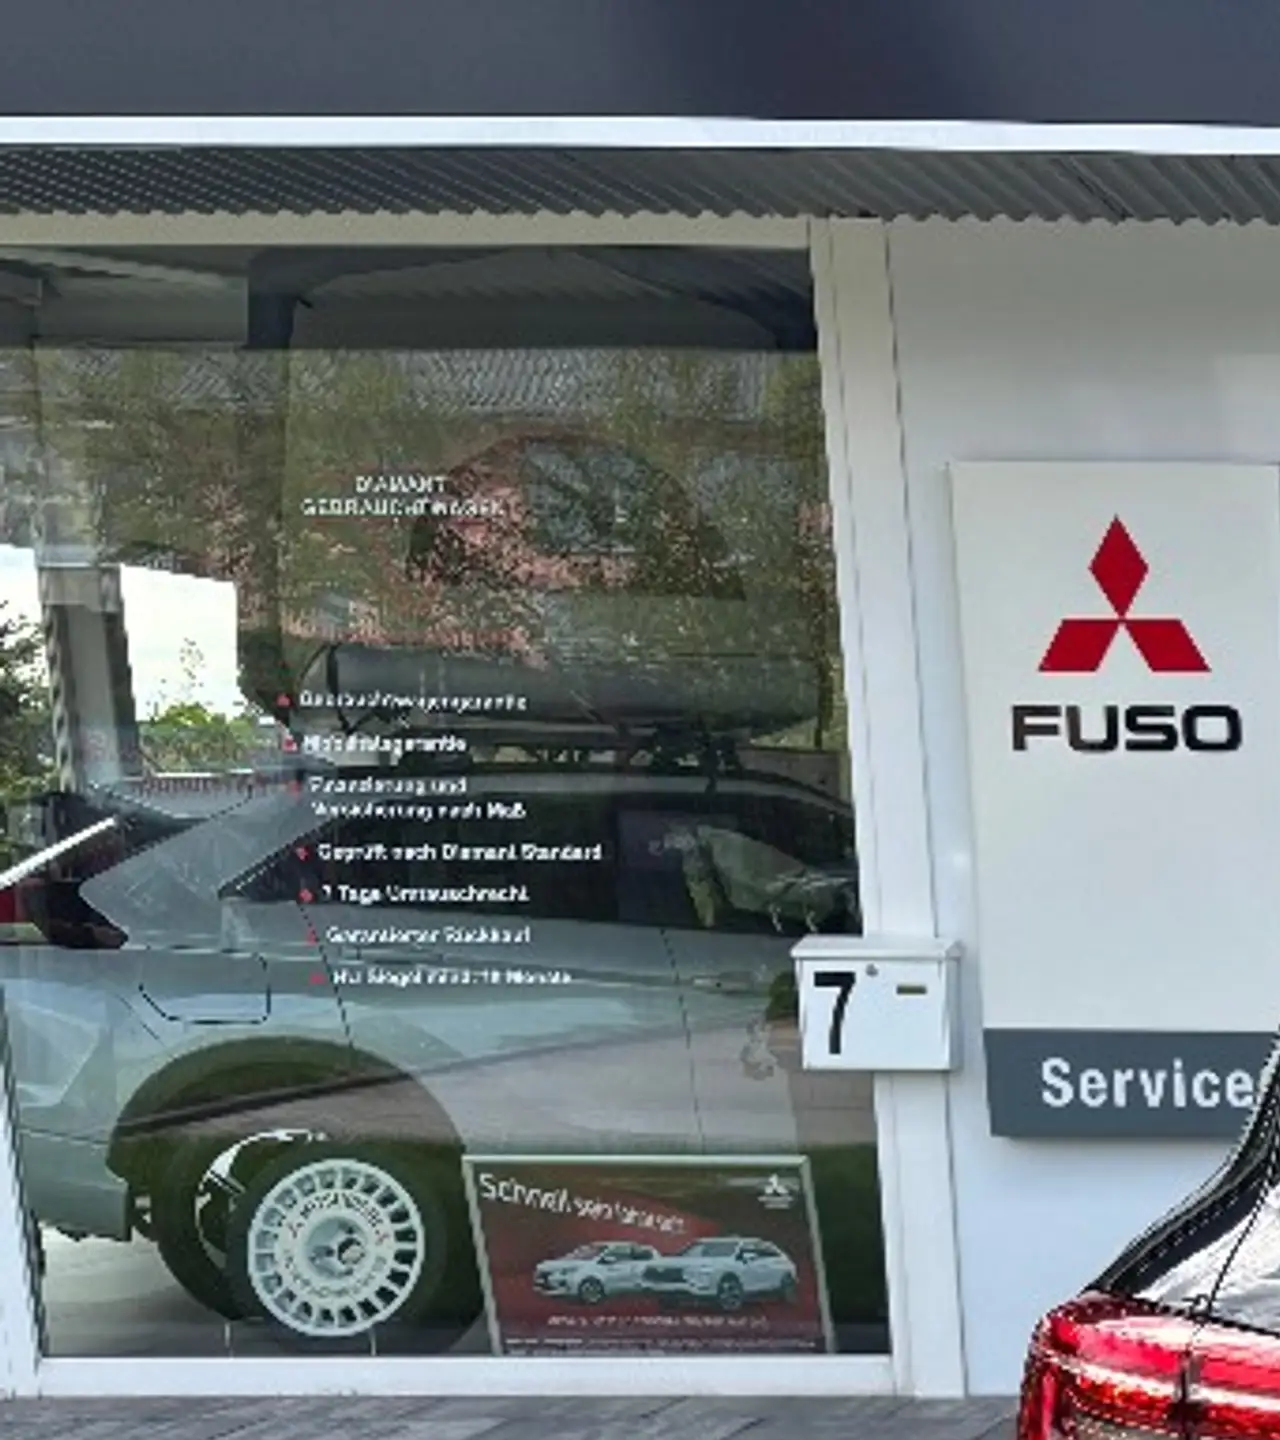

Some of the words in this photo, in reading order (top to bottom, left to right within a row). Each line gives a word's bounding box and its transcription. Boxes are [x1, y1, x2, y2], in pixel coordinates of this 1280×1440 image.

[1012, 705, 1243, 752] FUSO
[337, 885, 381, 905] Tage
[813, 971, 857, 1055] 7
[1041, 1056, 1255, 1109] Service
